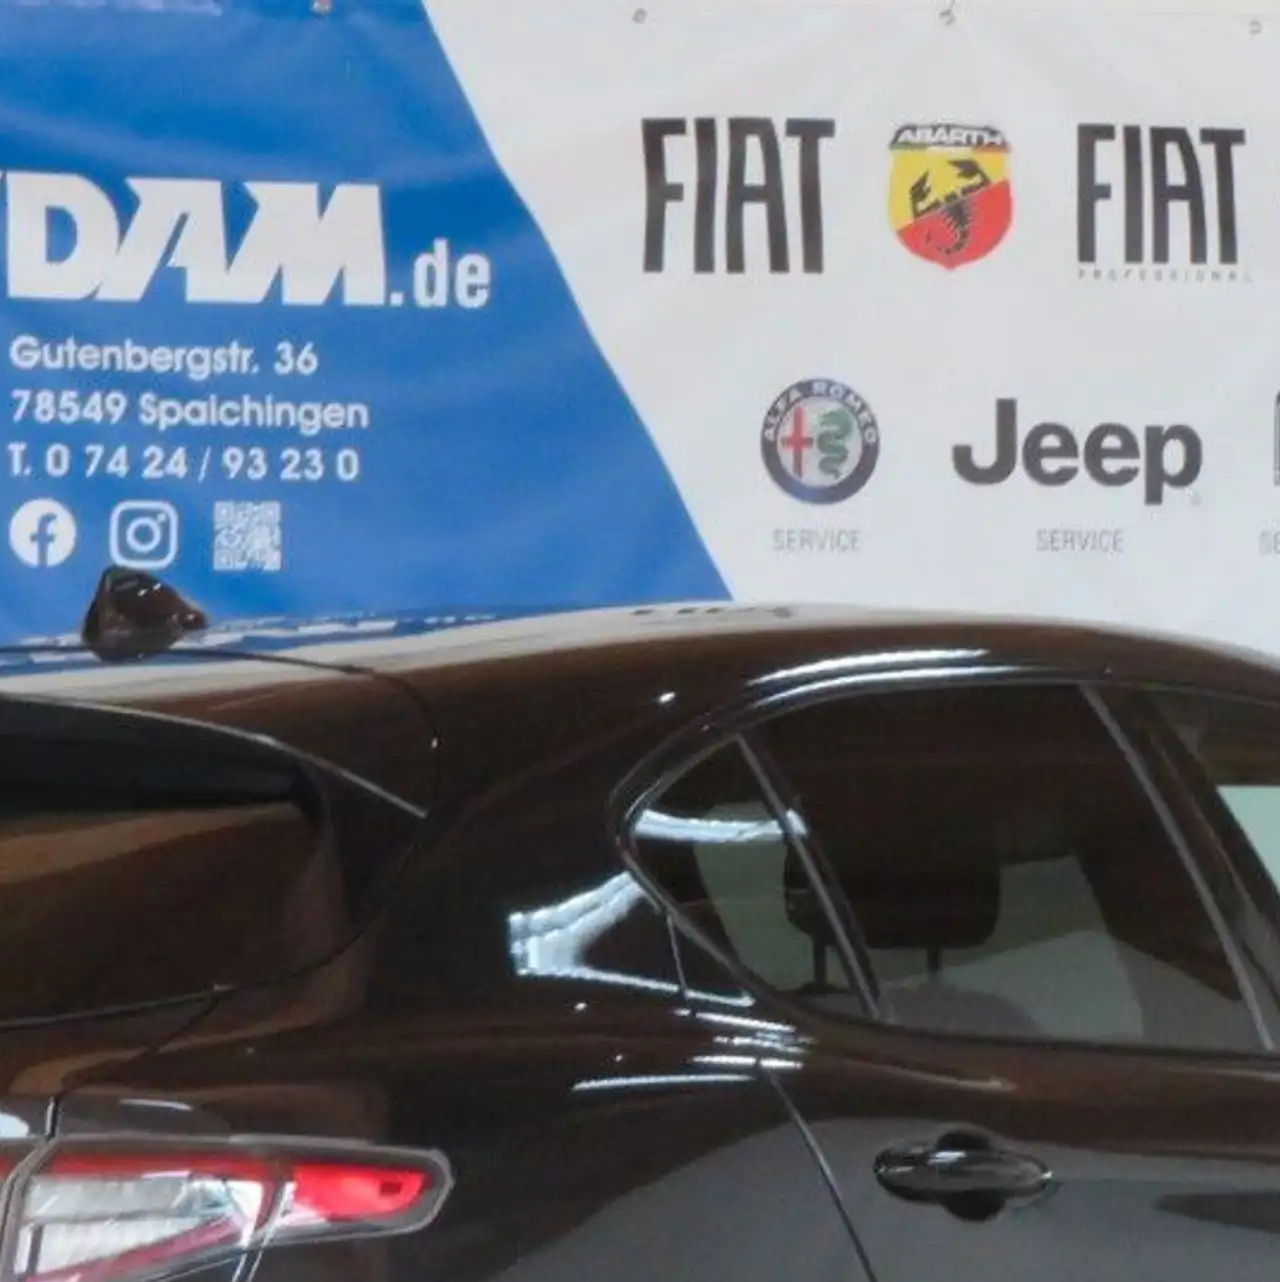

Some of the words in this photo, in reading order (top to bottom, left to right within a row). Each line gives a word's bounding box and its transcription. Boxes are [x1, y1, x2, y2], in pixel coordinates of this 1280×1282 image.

[898, 126, 1003, 146] ABARTH
[642, 117, 835, 273] FIAT
[1077, 124, 1246, 264] FIAT
[9, 335, 260, 380] Gutenbergstr.
[274, 342, 318, 376] 36
[11, 391, 127, 425] 78549
[138, 395, 370, 435] Spaichingen
[812, 380, 877, 443] ROMEO
[9, 442, 32, 477] T.
[46, 444, 70, 478] 0
[84, 445, 129, 478] 74
[142, 446, 188, 479] 24
[197, 446, 213, 483] /
[225, 448, 268, 480] 93
[280, 449, 324, 481] 23
[336, 448, 360, 482] 0
[951, 397, 1203, 506] Jeep
[772, 528, 861, 552] SERVICE
[1035, 528, 1124, 553] SERVICE
